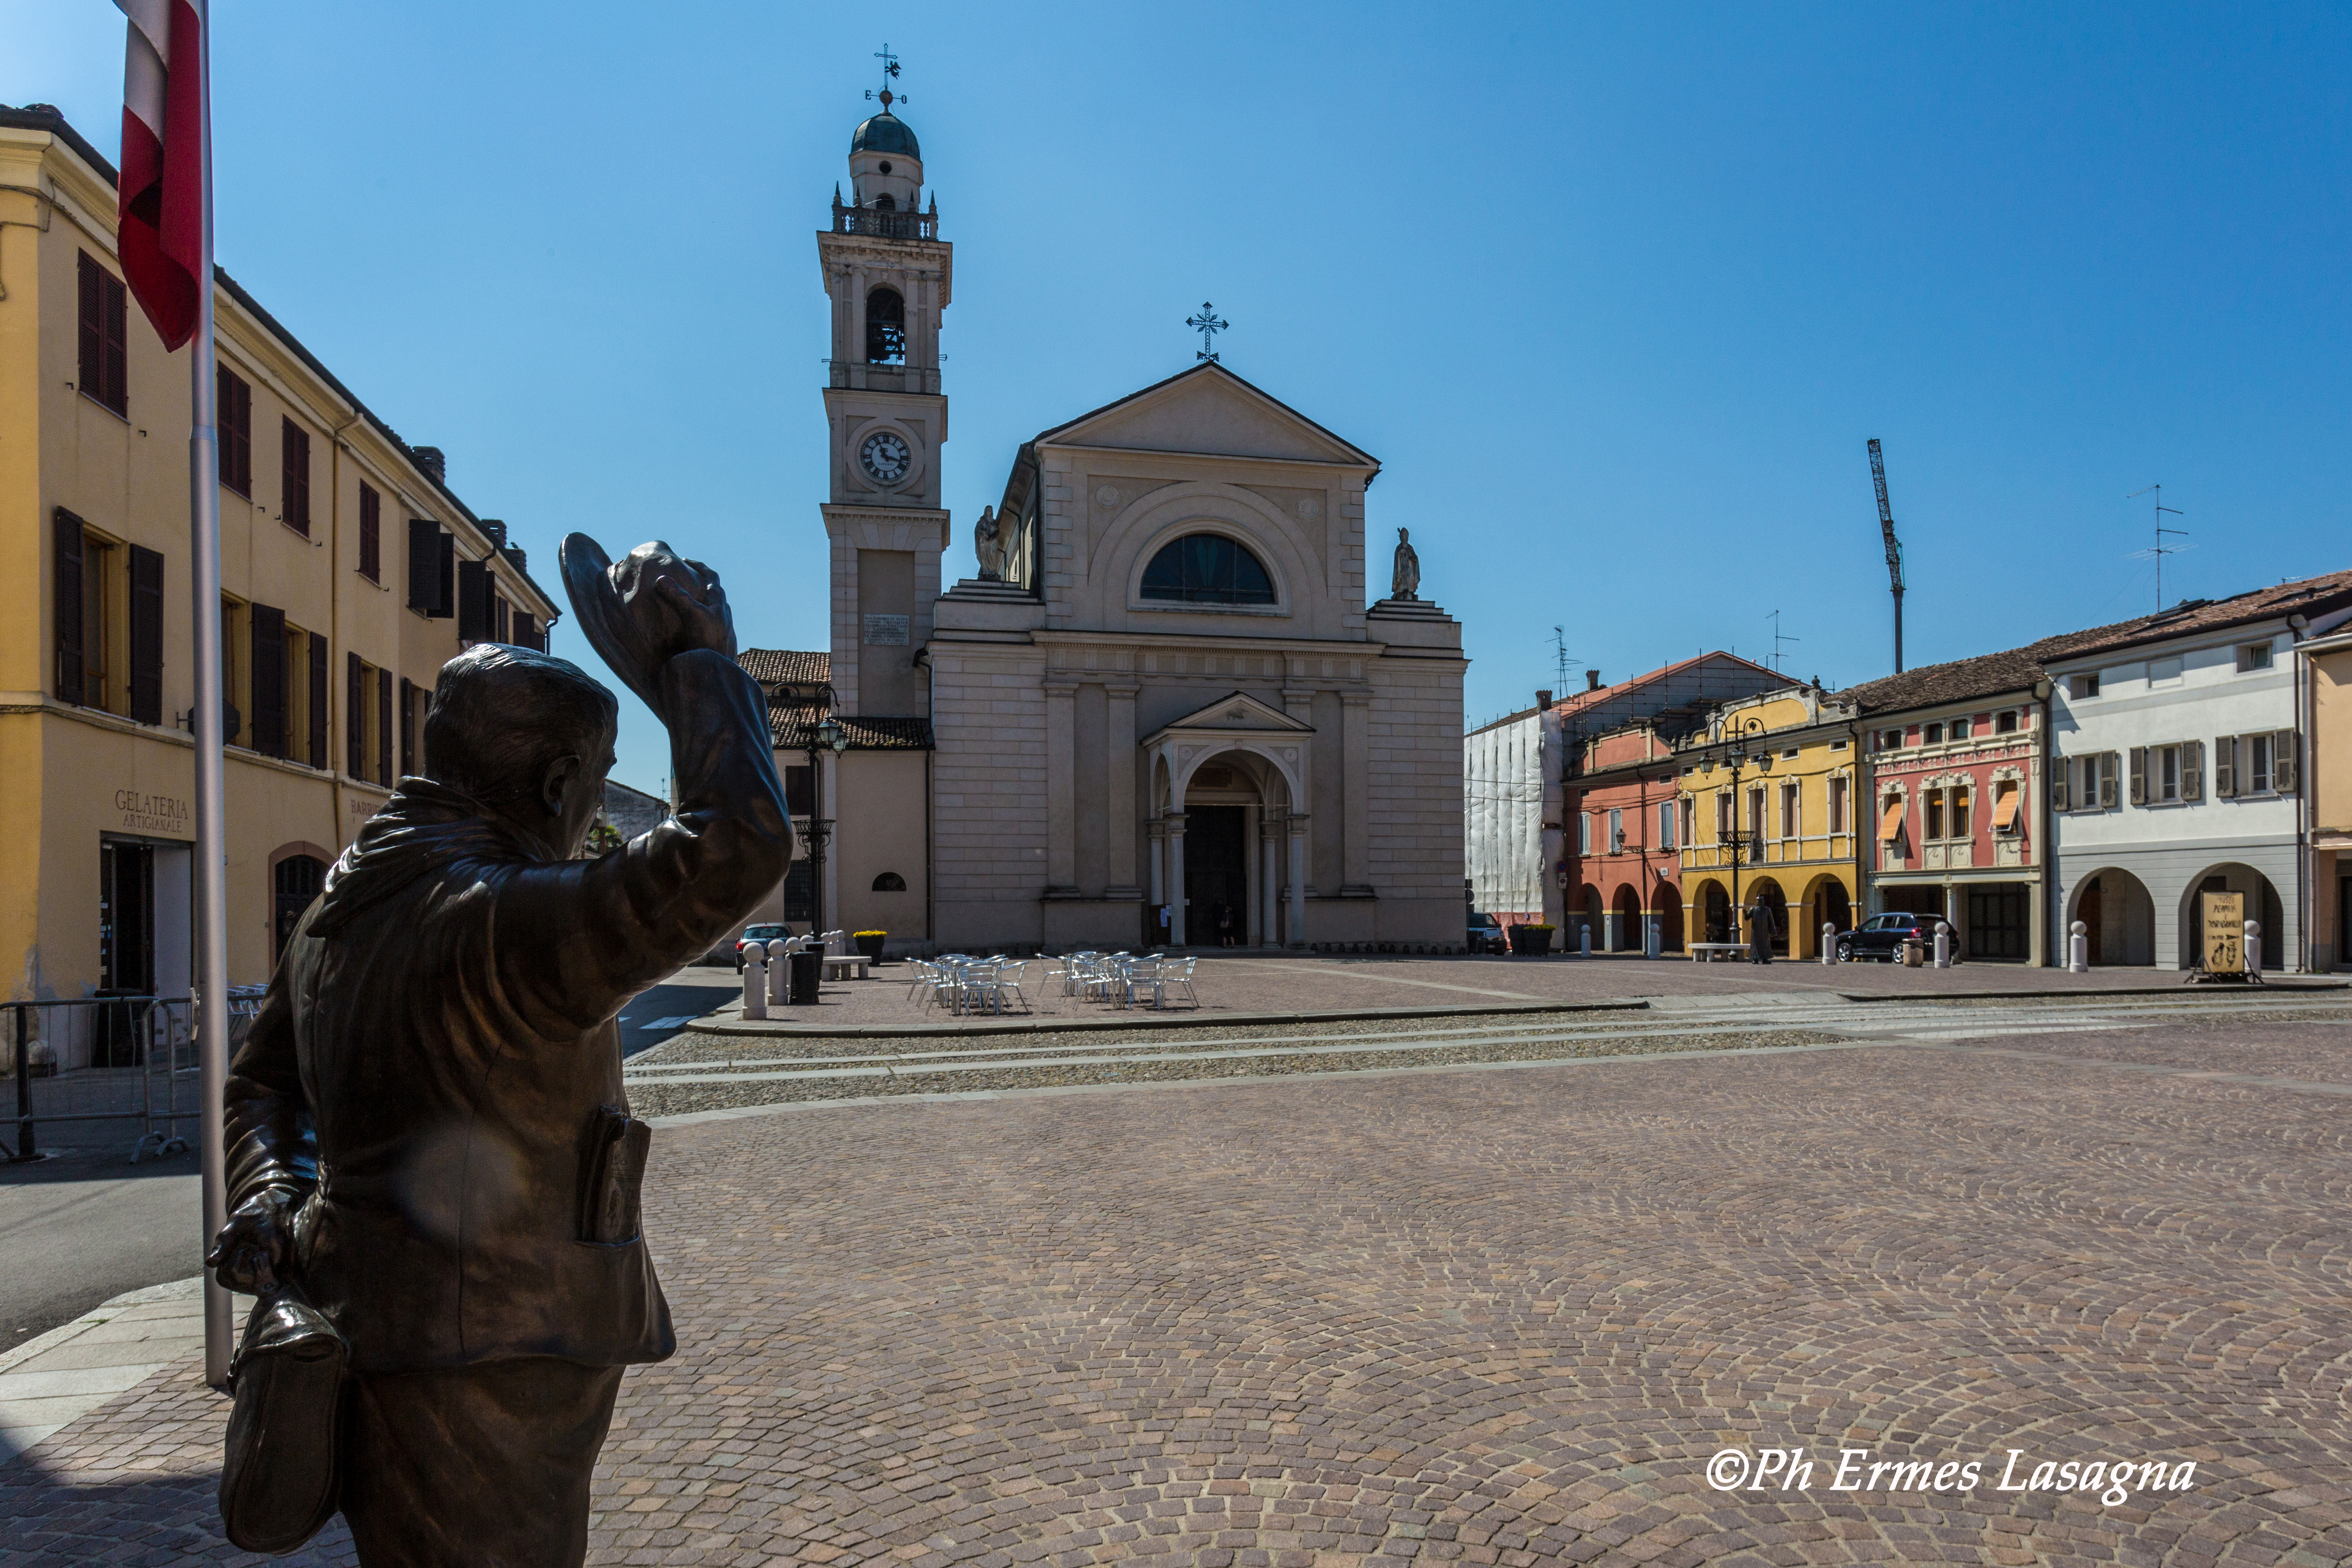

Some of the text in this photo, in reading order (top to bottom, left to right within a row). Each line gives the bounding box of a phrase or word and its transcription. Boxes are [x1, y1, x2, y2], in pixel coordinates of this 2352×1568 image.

[865, 90, 871, 100] E
[115, 790, 188, 819] GELATERIA
[123, 814, 182, 833] ARTIGIANALE
